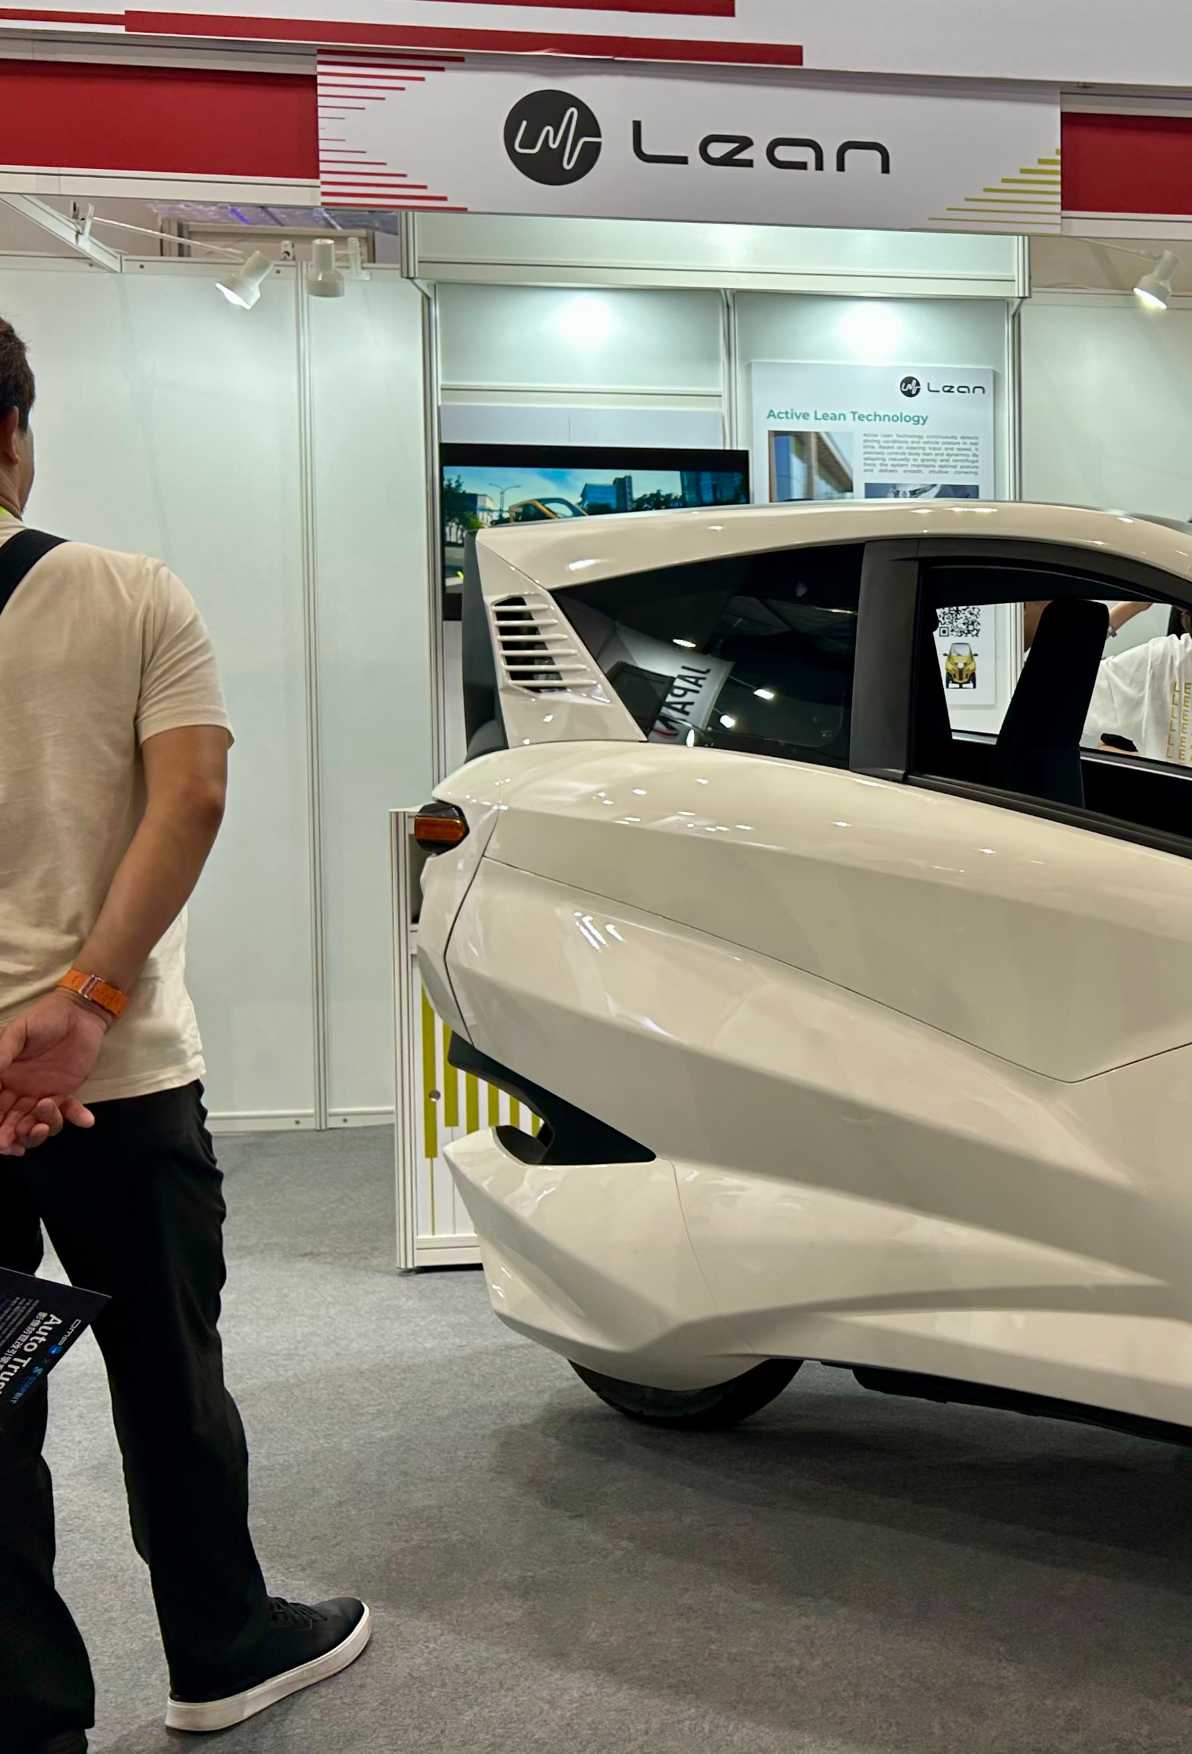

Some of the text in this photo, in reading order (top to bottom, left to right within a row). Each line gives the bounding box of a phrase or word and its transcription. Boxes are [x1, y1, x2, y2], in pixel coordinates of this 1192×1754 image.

[633, 120, 890, 174] Lean
[927, 382, 985, 395] Lean
[767, 409, 928, 425] Active Lean Technology
[23, 1313, 63, 1352] Auto
[0, 1357, 32, 1395] Tru
